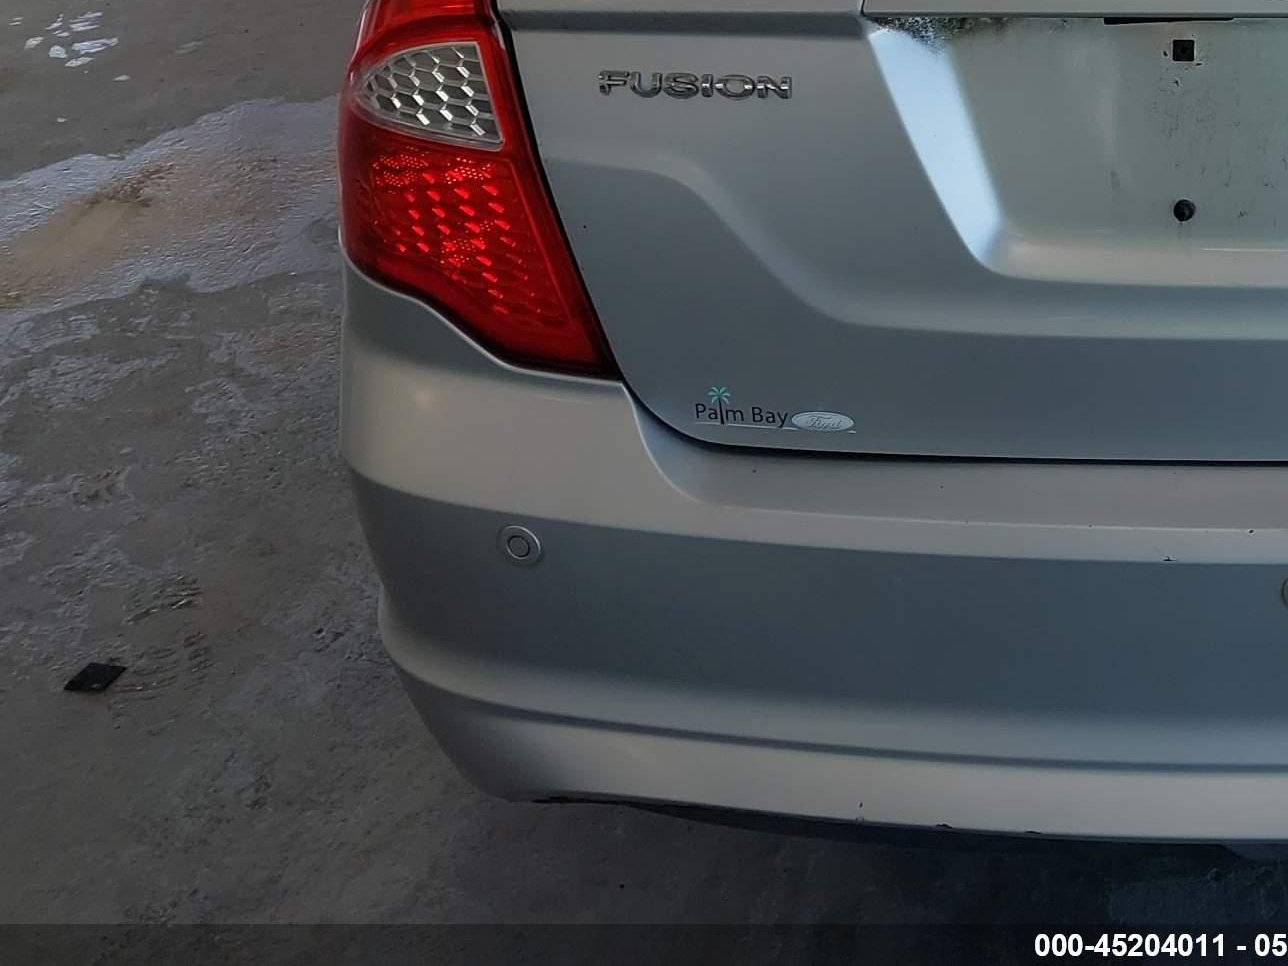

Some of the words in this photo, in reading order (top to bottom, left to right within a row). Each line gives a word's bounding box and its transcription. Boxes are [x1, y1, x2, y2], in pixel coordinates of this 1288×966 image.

[597, 70, 793, 101] FUSION
[695, 399, 744, 425] Palm
[751, 406, 788, 429] Bay
